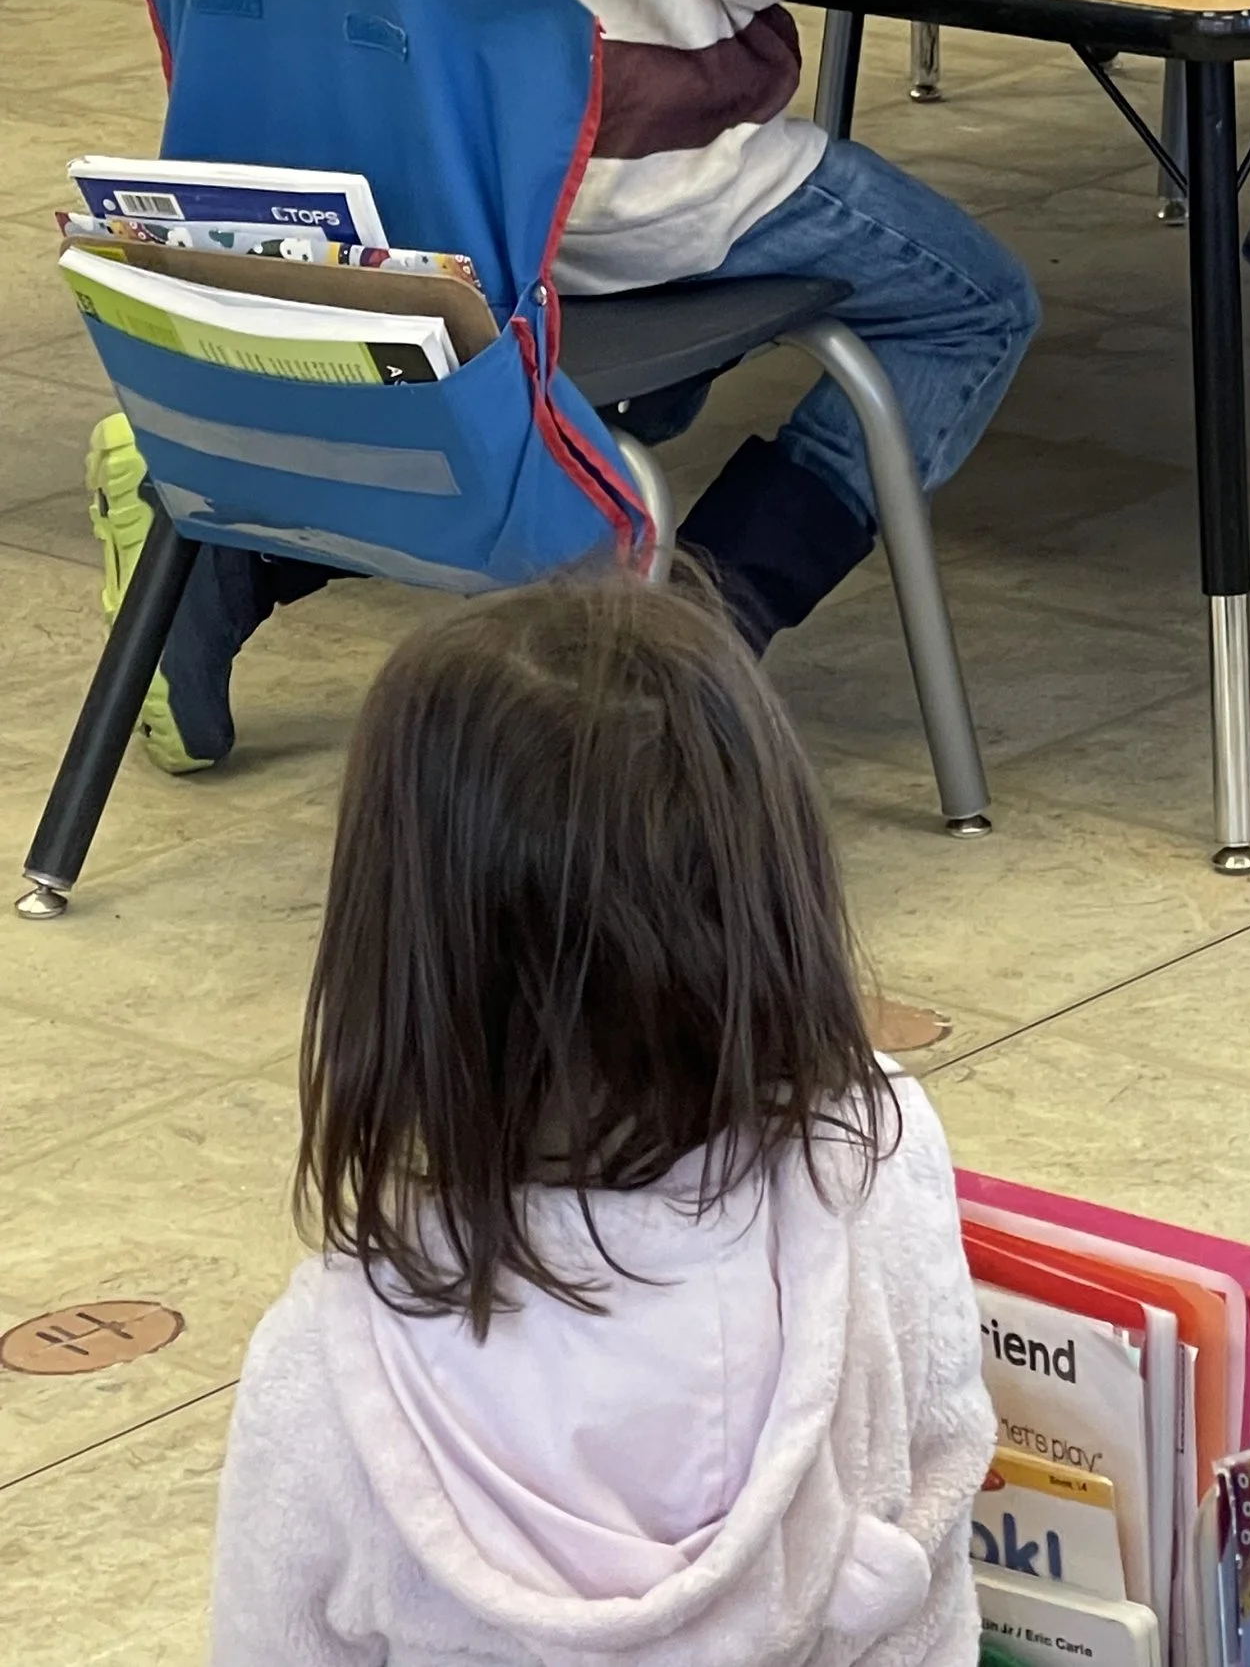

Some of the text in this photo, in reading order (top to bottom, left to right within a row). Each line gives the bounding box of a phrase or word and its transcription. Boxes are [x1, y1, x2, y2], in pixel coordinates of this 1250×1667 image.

[282, 206, 340, 226] TOPS
[1026, 1628, 1052, 1646] Eric
[1055, 1637, 1093, 1657] Carle
